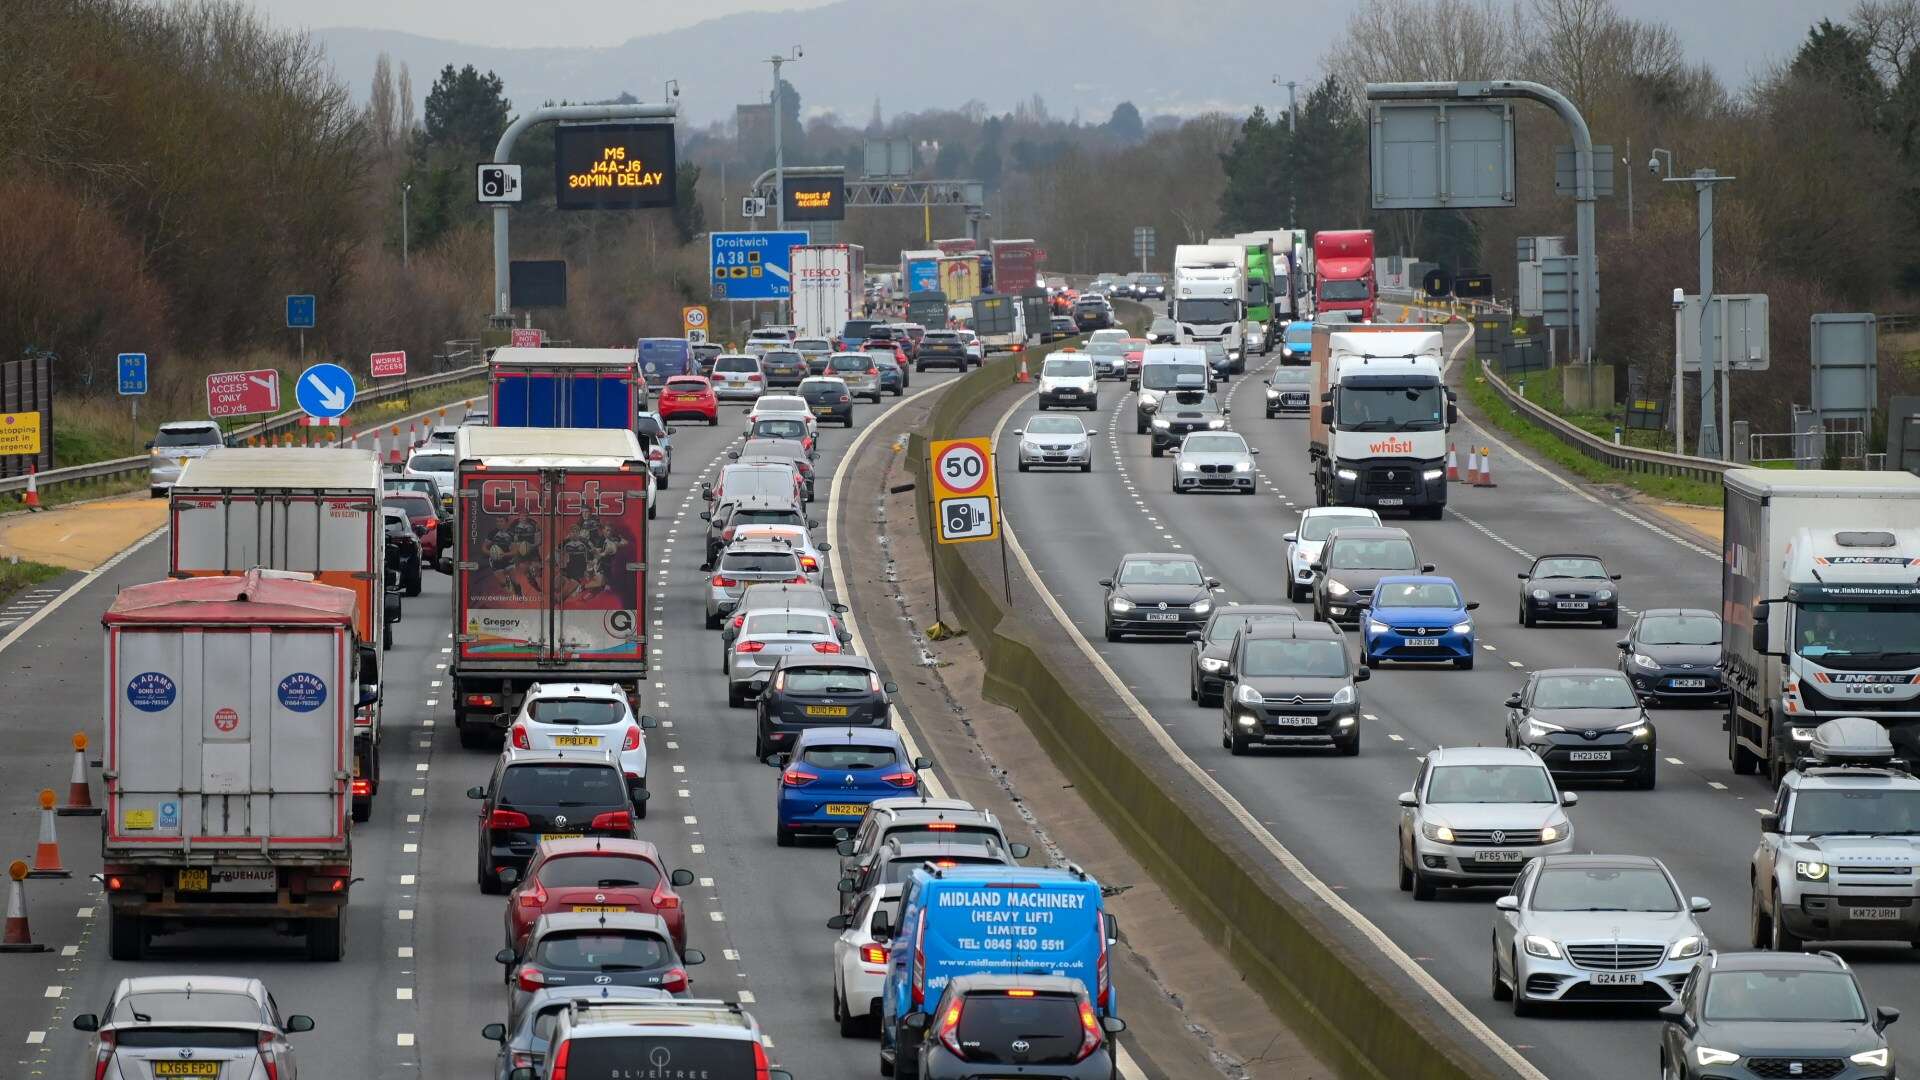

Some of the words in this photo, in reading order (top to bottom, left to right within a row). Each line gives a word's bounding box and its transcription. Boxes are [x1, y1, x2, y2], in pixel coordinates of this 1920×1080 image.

[604, 147, 625, 160] M5
[590, 160, 641, 173] J4A-J6
[569, 174, 612, 188] 30MIN
[617, 173, 663, 186] DELAY
[795, 191, 820, 200] Report
[822, 191, 831, 199] of
[798, 199, 829, 207] accident
[716, 238, 769, 247] Droitwich
[802, 269, 840, 277] TESCO
[689, 313, 703, 321] 50
[375, 356, 401, 365] WORKS
[375, 363, 403, 372] ACCESS
[210, 374, 247, 384] WORKS
[210, 383, 249, 394] ACCESS
[218, 393, 241, 402] ONLY
[212, 405, 229, 414] 100
[231, 404, 247, 414] yds
[1369, 436, 1413, 453] whistl
[946, 455, 981, 477] 50
[482, 479, 625, 516] Chiefs
[483, 617, 521, 627] Gregory
[141, 675, 172, 690] ADAMS
[291, 675, 323, 690] ADAMS
[1834, 674, 1907, 683] LINKLINE
[1845, 684, 1895, 694] IVECO
[578, 736, 593, 745] LFA
[1573, 752, 1592, 760] FH23
[829, 805, 850, 813] HN22
[1479, 852, 1500, 861] AF65
[1502, 852, 1519, 860] YNP
[939, 892, 1001, 907] MIDLAND
[1006, 892, 1086, 909] MACHINERY
[971, 910, 1020, 924] (HEAVY
[1025, 911, 1054, 924] LIFT)
[1853, 909, 1878, 918] KM72
[987, 925, 1038, 936] LIMITED
[958, 938, 981, 949] TEL:
[984, 939, 1012, 950] 0845
[1016, 939, 1037, 950] 430
[1040, 939, 1065, 951] 5511
[1597, 974, 1616, 983] G24
[1618, 974, 1637, 983] AFR
[160, 1063, 189, 1073] LX66
